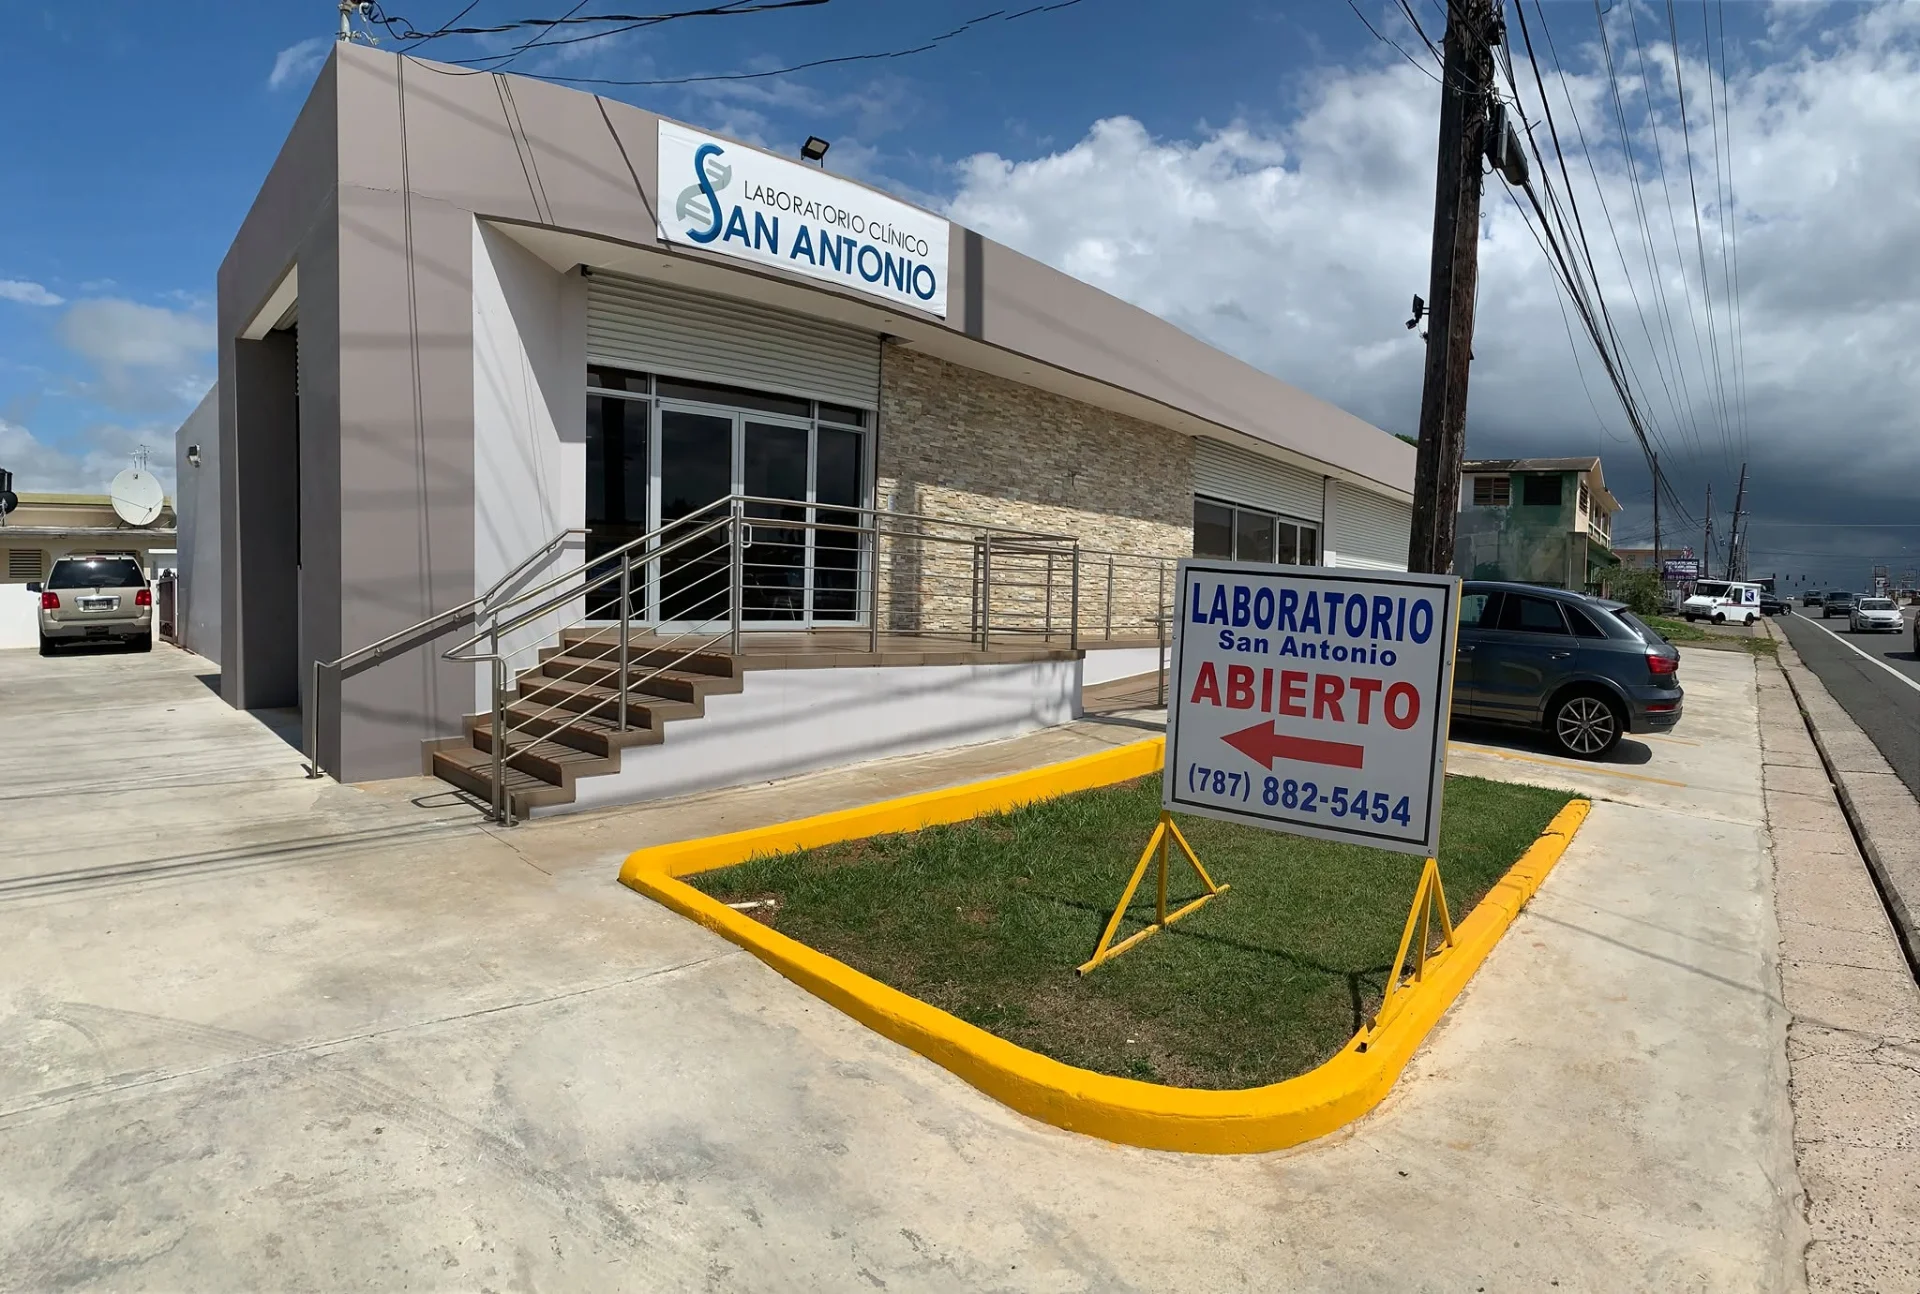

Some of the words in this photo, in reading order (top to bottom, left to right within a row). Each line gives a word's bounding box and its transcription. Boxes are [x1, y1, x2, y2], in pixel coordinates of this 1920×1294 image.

[686, 143, 779, 255] SAN
[790, 225, 936, 301] ANTONIO
[744, 180, 865, 234] LABORATORIO
[869, 222, 929, 257] CLÍNICO
[1191, 582, 1434, 644] LABORATORIO
[1218, 629, 1268, 654] San
[1279, 635, 1397, 667] Antonio
[1190, 661, 1421, 730] ABIERTO
[1188, 762, 1251, 802] (787)
[1262, 776, 1411, 827] 882-5454
